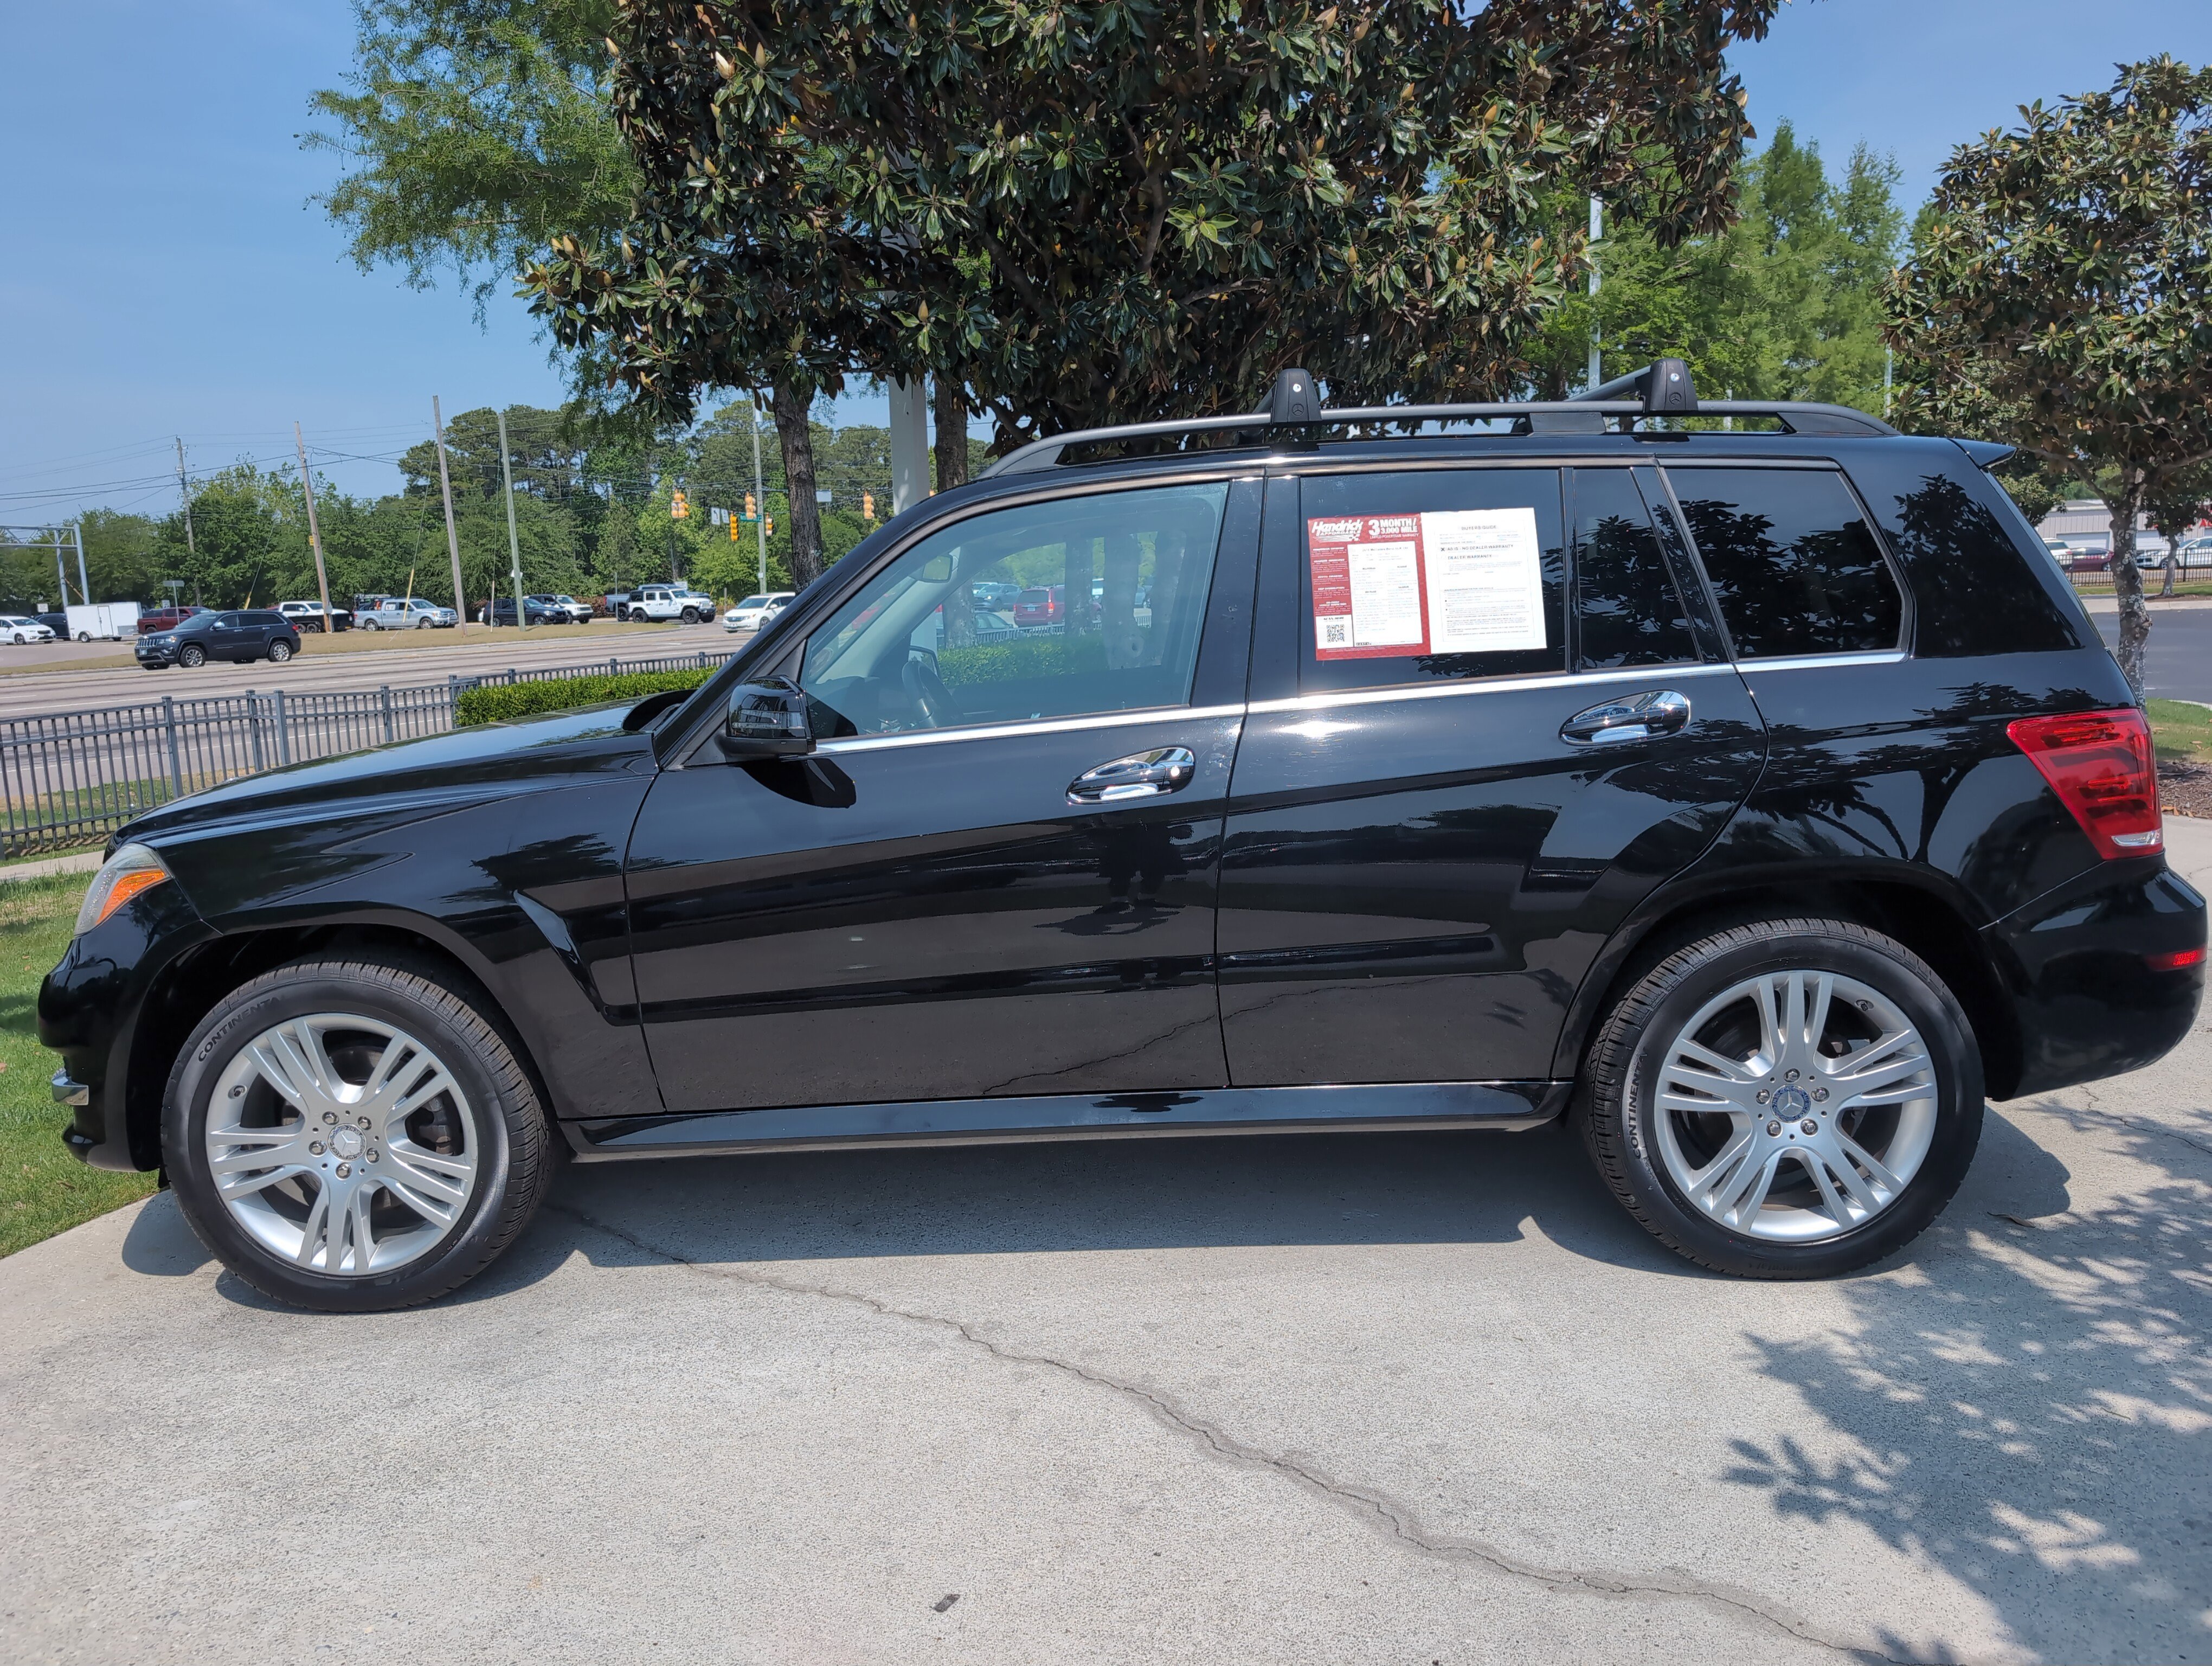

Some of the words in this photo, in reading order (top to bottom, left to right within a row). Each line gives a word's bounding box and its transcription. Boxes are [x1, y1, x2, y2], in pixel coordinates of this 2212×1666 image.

[1311, 519, 1364, 536] Hendrick
[1368, 519, 1380, 536] 3
[1380, 517, 1417, 528] MONTH/
[198, 997, 281, 1062] CONTINENTA
[1628, 1053, 1648, 1159] CONTINENTA
